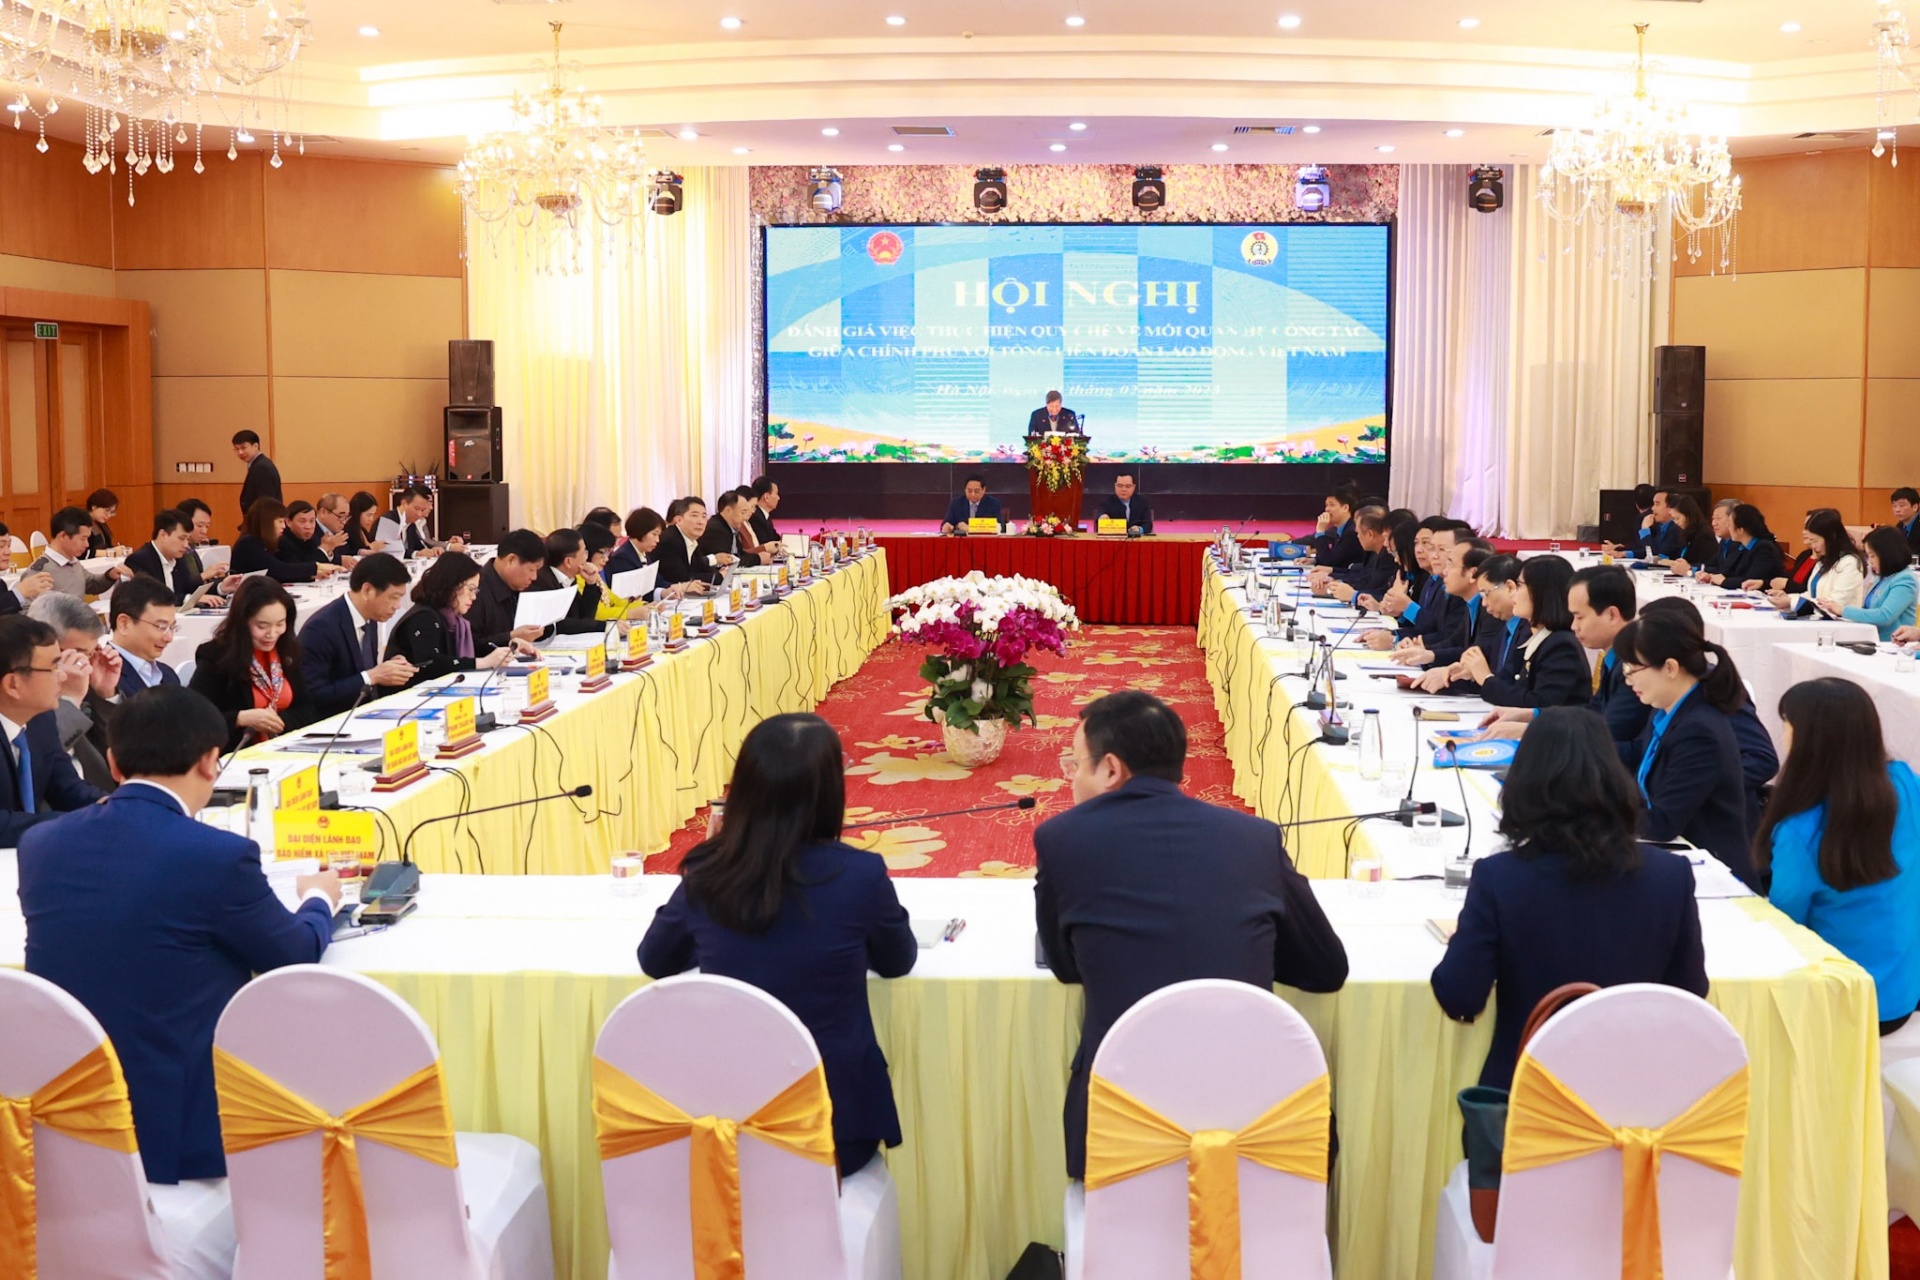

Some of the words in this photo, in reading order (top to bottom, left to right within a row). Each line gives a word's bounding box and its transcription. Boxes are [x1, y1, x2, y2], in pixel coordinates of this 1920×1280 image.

[953, 277, 1049, 314] HỘI
[1066, 280, 1201, 314] NGHỊ
[37, 325, 56, 336] EXIT
[788, 323, 839, 338] ĐÁNH
[843, 323, 876, 337] GIÁ
[879, 323, 917, 339] VIỆC
[982, 323, 1027, 339] HIỆN
[1031, 325, 1067, 338] QUY
[1186, 325, 1239, 339] QUAN
[857, 343, 917, 358] CHÍNH
[1303, 346, 1347, 357] NAM
